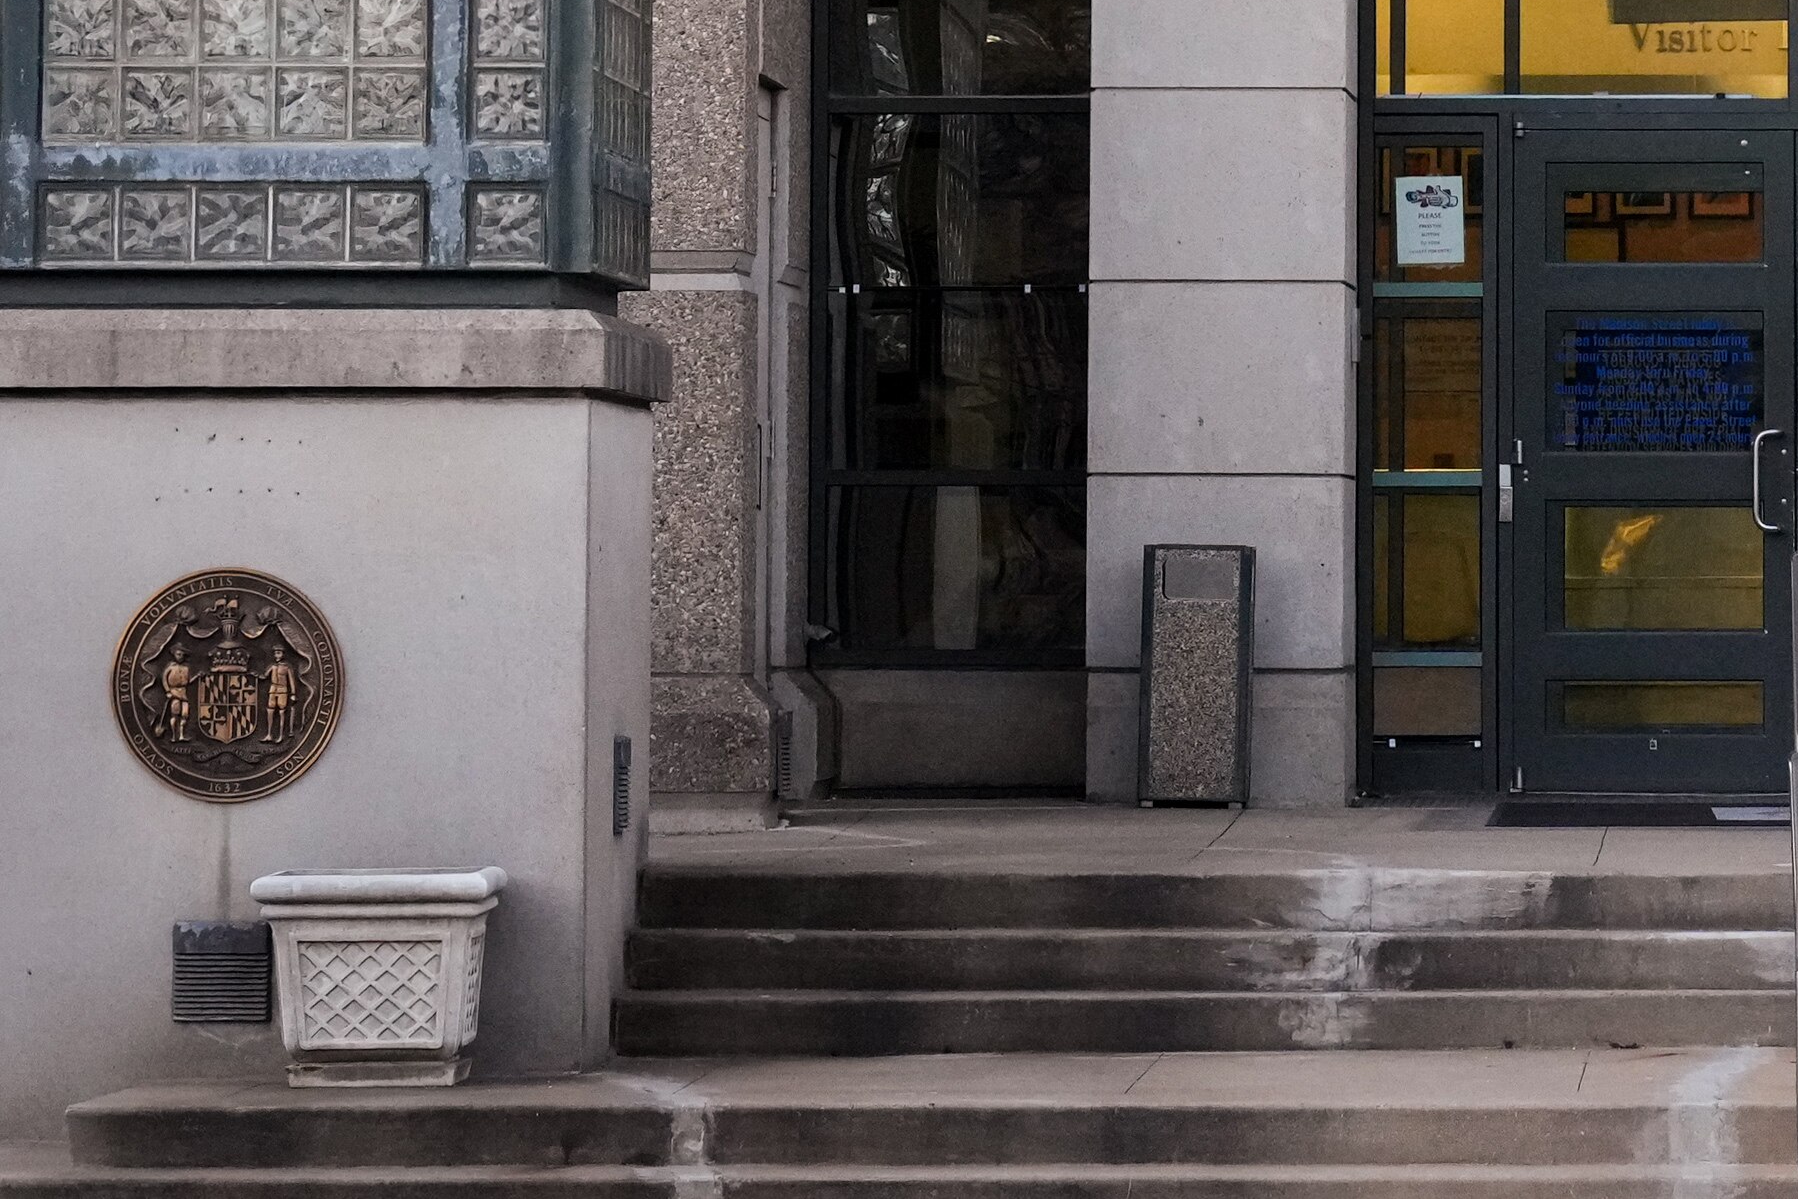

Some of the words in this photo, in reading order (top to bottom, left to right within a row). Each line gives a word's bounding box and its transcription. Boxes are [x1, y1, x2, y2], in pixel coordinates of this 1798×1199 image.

[1628, 20, 1758, 53] Visitor
[1418, 212, 1442, 220] PLEASE
[1711, 334, 1750, 349] during
[1596, 366, 1642, 382] Monday
[312, 629, 336, 726] CORONASTI
[274, 752, 305, 778] NOS
[208, 782, 241, 793] 1632
